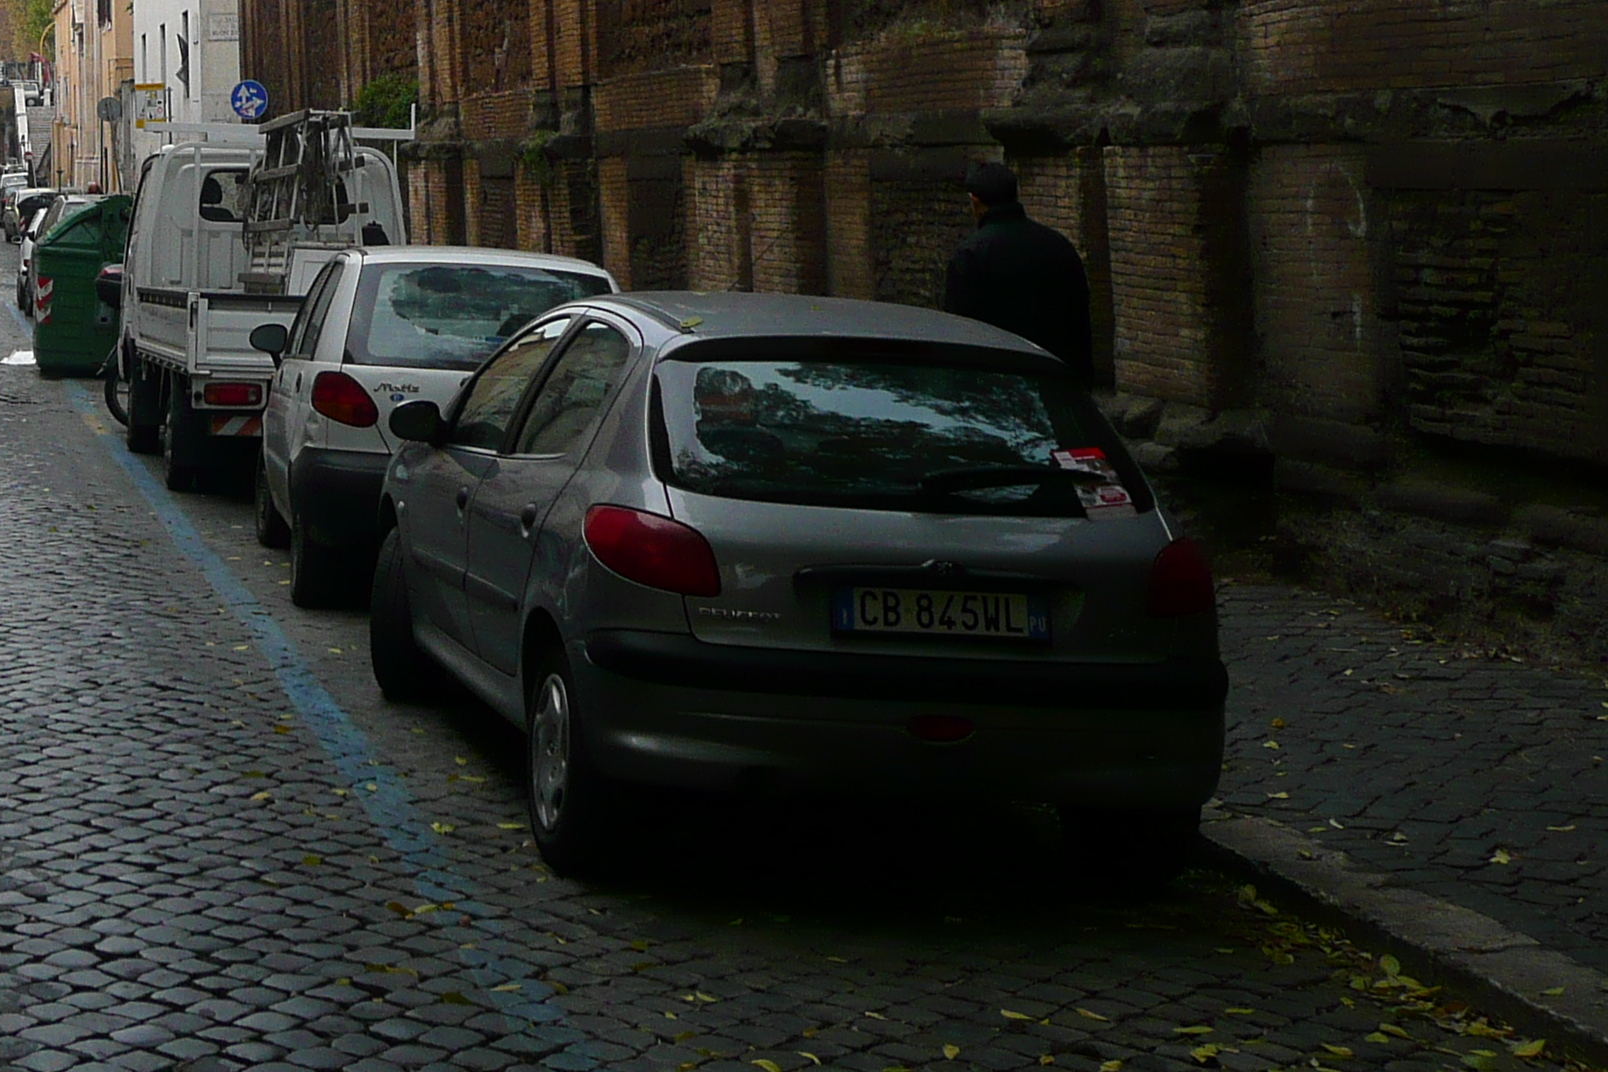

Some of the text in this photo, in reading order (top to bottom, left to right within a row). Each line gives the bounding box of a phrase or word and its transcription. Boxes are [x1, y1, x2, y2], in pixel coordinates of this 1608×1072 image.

[373, 383, 420, 393] Matiz
[859, 590, 902, 627] CB
[915, 593, 1024, 633] 845WL
